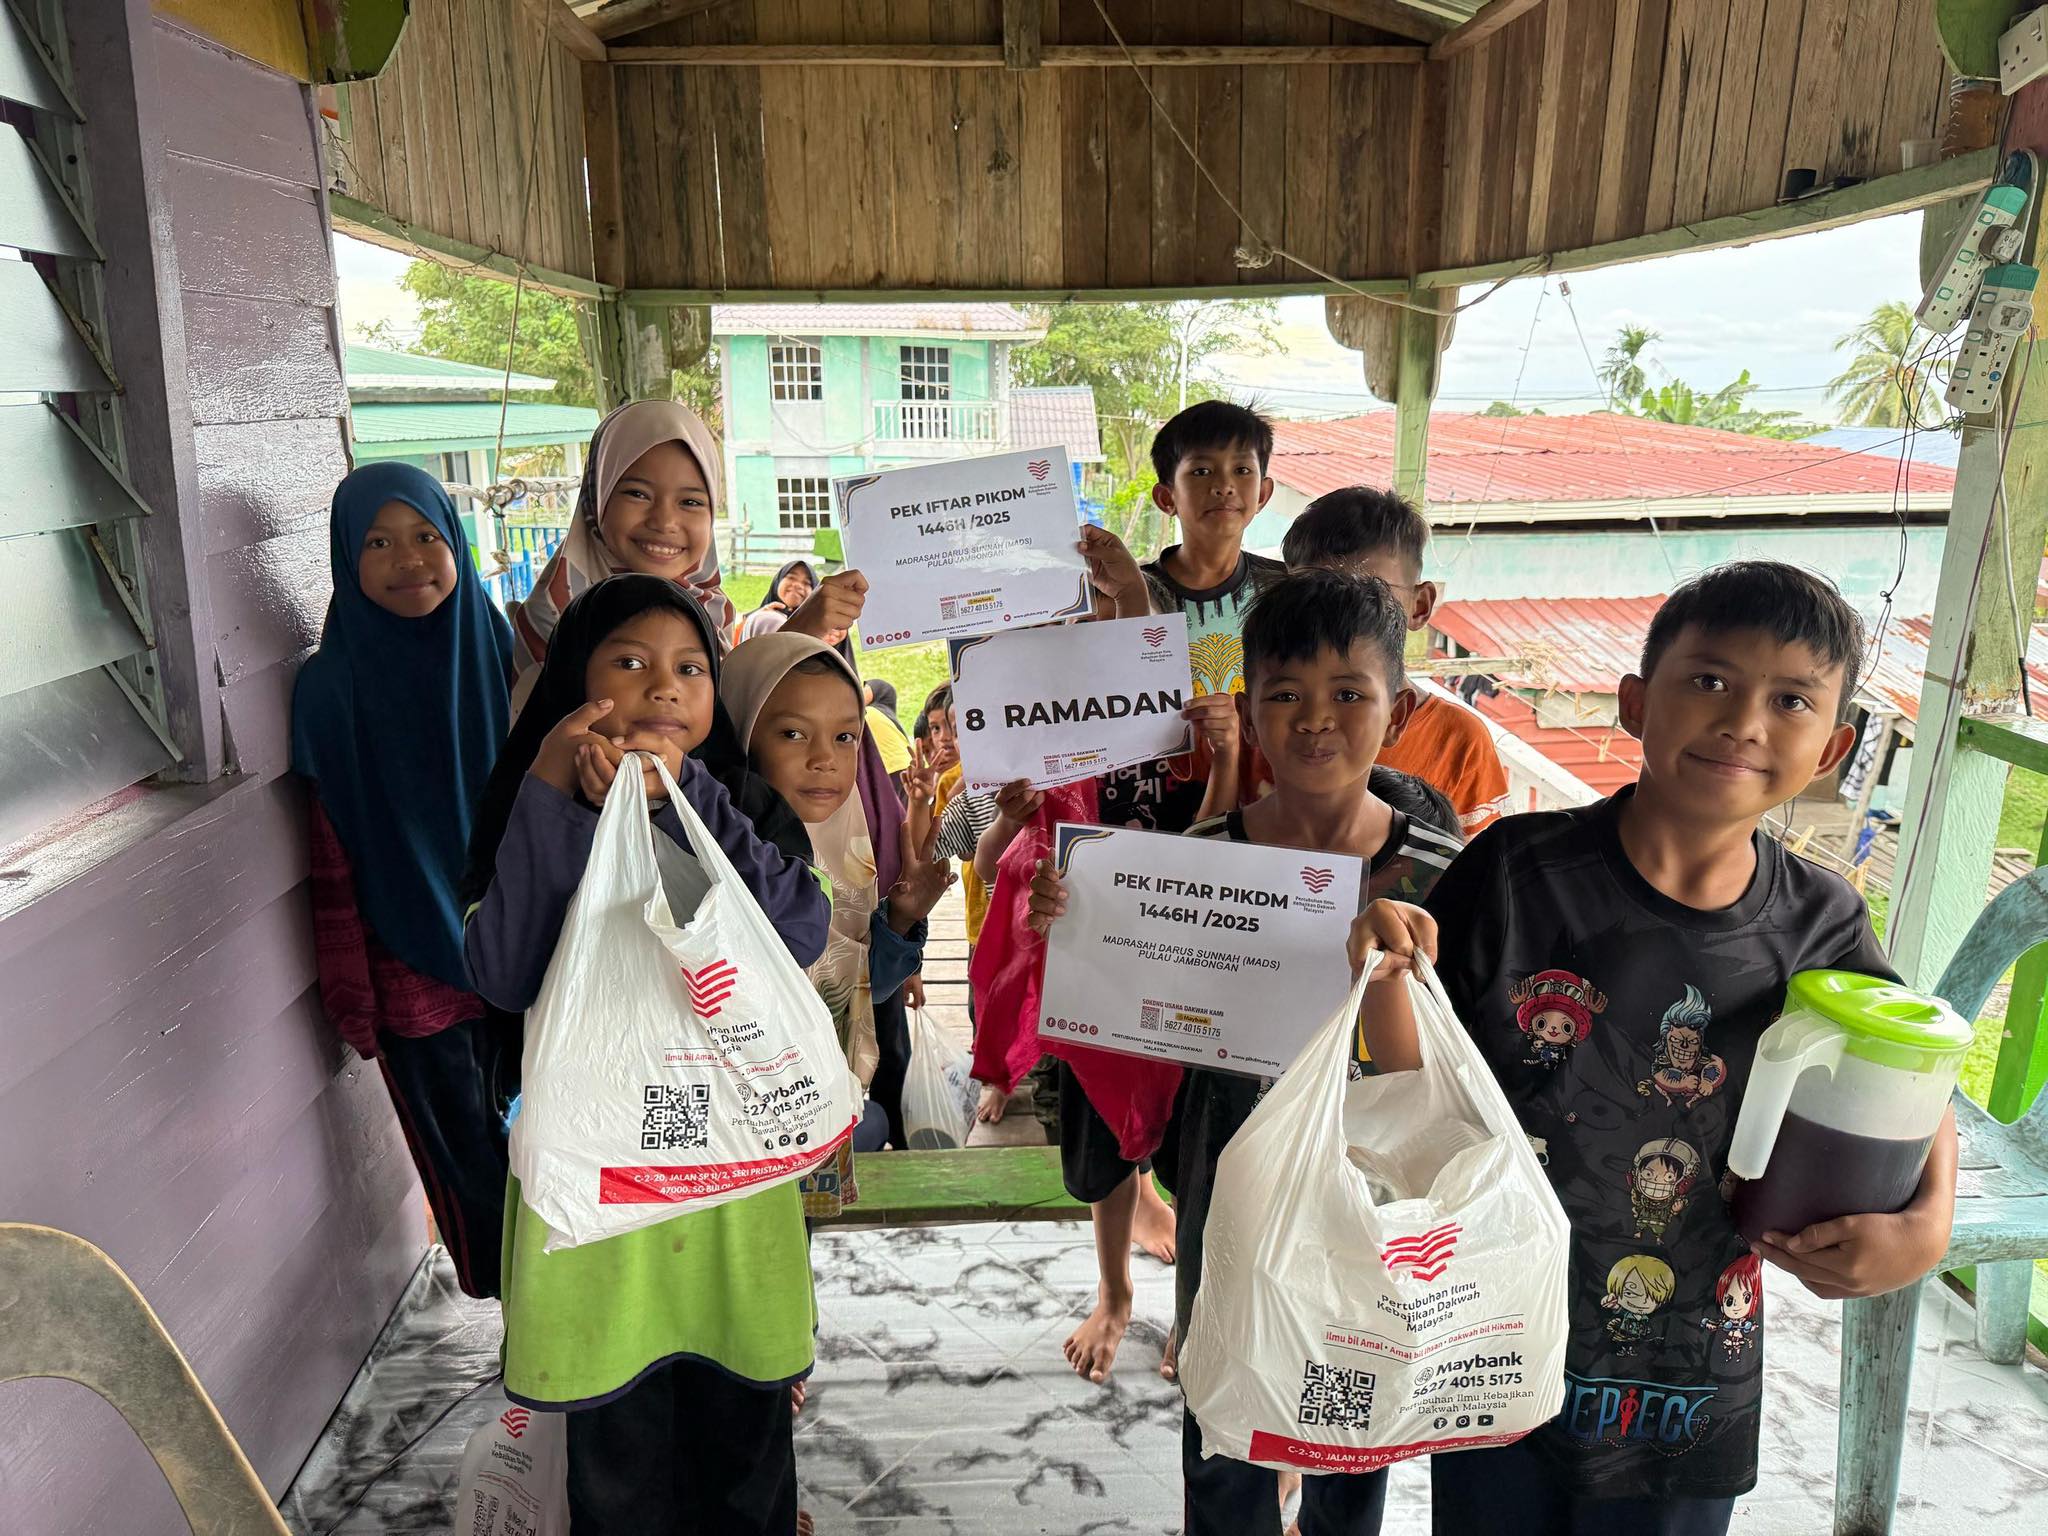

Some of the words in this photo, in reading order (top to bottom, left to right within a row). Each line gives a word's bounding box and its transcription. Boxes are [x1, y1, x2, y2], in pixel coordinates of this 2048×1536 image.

[890, 503, 923, 519] PEK
[926, 496, 971, 514] IFTAR
[975, 487, 1026, 506] PIKDM
[917, 518, 966, 536] 1446H
[970, 511, 1011, 530] /2025
[896, 553, 940, 566] MADRASAH
[942, 547, 969, 559] DARUS
[971, 542, 1004, 554] SUNNAH
[1005, 537, 1033, 550] (MADS)
[927, 558, 954, 568] PULAU
[965, 708, 986, 731] 8
[1004, 689, 1183, 728] RAMADAN
[1113, 872, 1152, 892] PEK
[1156, 878, 1213, 901] IFTAR
[1218, 886, 1289, 910] PIKDM
[1139, 902, 1199, 925] 1446H
[1202, 909, 1260, 933] /2025
[1102, 935, 1157, 951] MADRASAH
[1158, 943, 1195, 957] DARUS
[1196, 949, 1241, 964] SUNNAH
[1242, 955, 1281, 972] (MADS)
[1138, 950, 1172, 963] PULAU
[1173, 955, 1239, 972] JAMBONGAN
[1142, 998, 1164, 1008] SOKONG
[1164, 1002, 1184, 1011] USAHA
[1184, 1005, 1209, 1015] DAKWAH
[1208, 1008, 1224, 1017] KAMI
[721, 1029, 765, 1044] Dakwah
[732, 1020, 758, 1034] Ilmu
[1164, 1020, 1182, 1031] 5627
[1182, 1023, 1201, 1034] 4015
[1202, 1026, 1221, 1037] 5175
[745, 1065, 775, 1076] Dakwah
[754, 1075, 816, 1104] aybank
[795, 1090, 820, 1110] 5175
[793, 1100, 833, 1121] Kebajikan
[634, 1174, 668, 1184] C-2-20,
[668, 1172, 699, 1182] JALAN
[698, 1172, 710, 1181] SP
[732, 1167, 750, 1179] SERI
[692, 1184, 705, 1193] SG
[1376, 1300, 1435, 1323] Kebajikan
[1437, 1290, 1481, 1312] Dakwah
[1381, 1288, 1448, 1311] Pertubuhan
[1451, 1281, 1476, 1296] Ilmu
[1406, 1311, 1454, 1333] Malaysia
[1325, 1331, 1346, 1343] Ilmu
[1347, 1334, 1359, 1346] bil
[1360, 1339, 1384, 1351] Amal
[1389, 1346, 1413, 1360] Amal
[1413, 1349, 1424, 1360] bil
[1448, 1327, 1479, 1344] Dakwah
[1479, 1325, 1490, 1334] bil
[1491, 1321, 1524, 1333] Hikmah
[1435, 1351, 1523, 1376] Maybank
[1412, 1378, 1447, 1399] 5627
[1450, 1375, 1485, 1388] 4015
[1488, 1372, 1523, 1386] 5175
[1399, 1394, 1454, 1414] Pertubuhan
[1457, 1393, 1480, 1403] Ilmu
[1483, 1390, 1534, 1401] Kebajikan
[1417, 1403, 1459, 1415] Dakwah
[1462, 1401, 1507, 1411] Malaysia
[1288, 1445, 1324, 1461] C-2-20,
[1325, 1453, 1355, 1462] JALAN
[1358, 1455, 1369, 1463] SP
